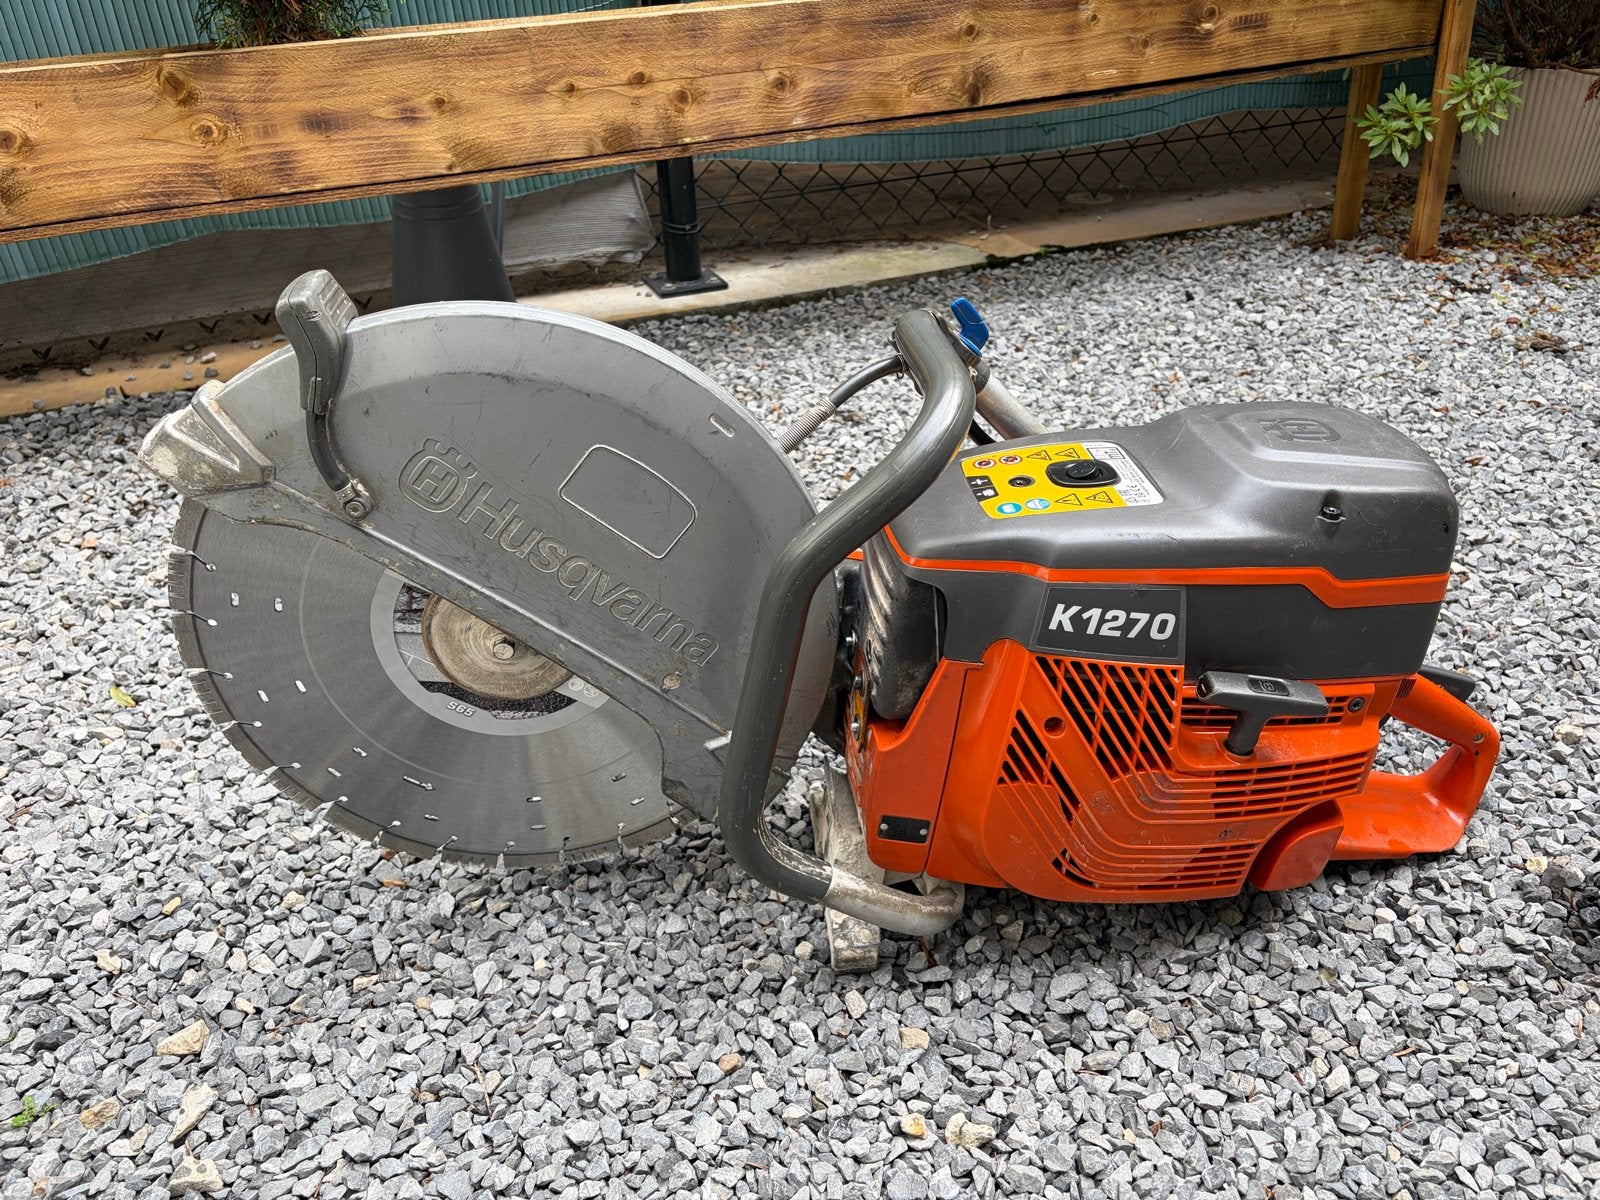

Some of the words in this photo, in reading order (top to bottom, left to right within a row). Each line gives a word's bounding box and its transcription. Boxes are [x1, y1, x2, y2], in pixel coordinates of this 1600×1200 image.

[457, 481, 720, 668] Husqvarna
[1048, 603, 1177, 641] K1270
[446, 700, 476, 718] S65
